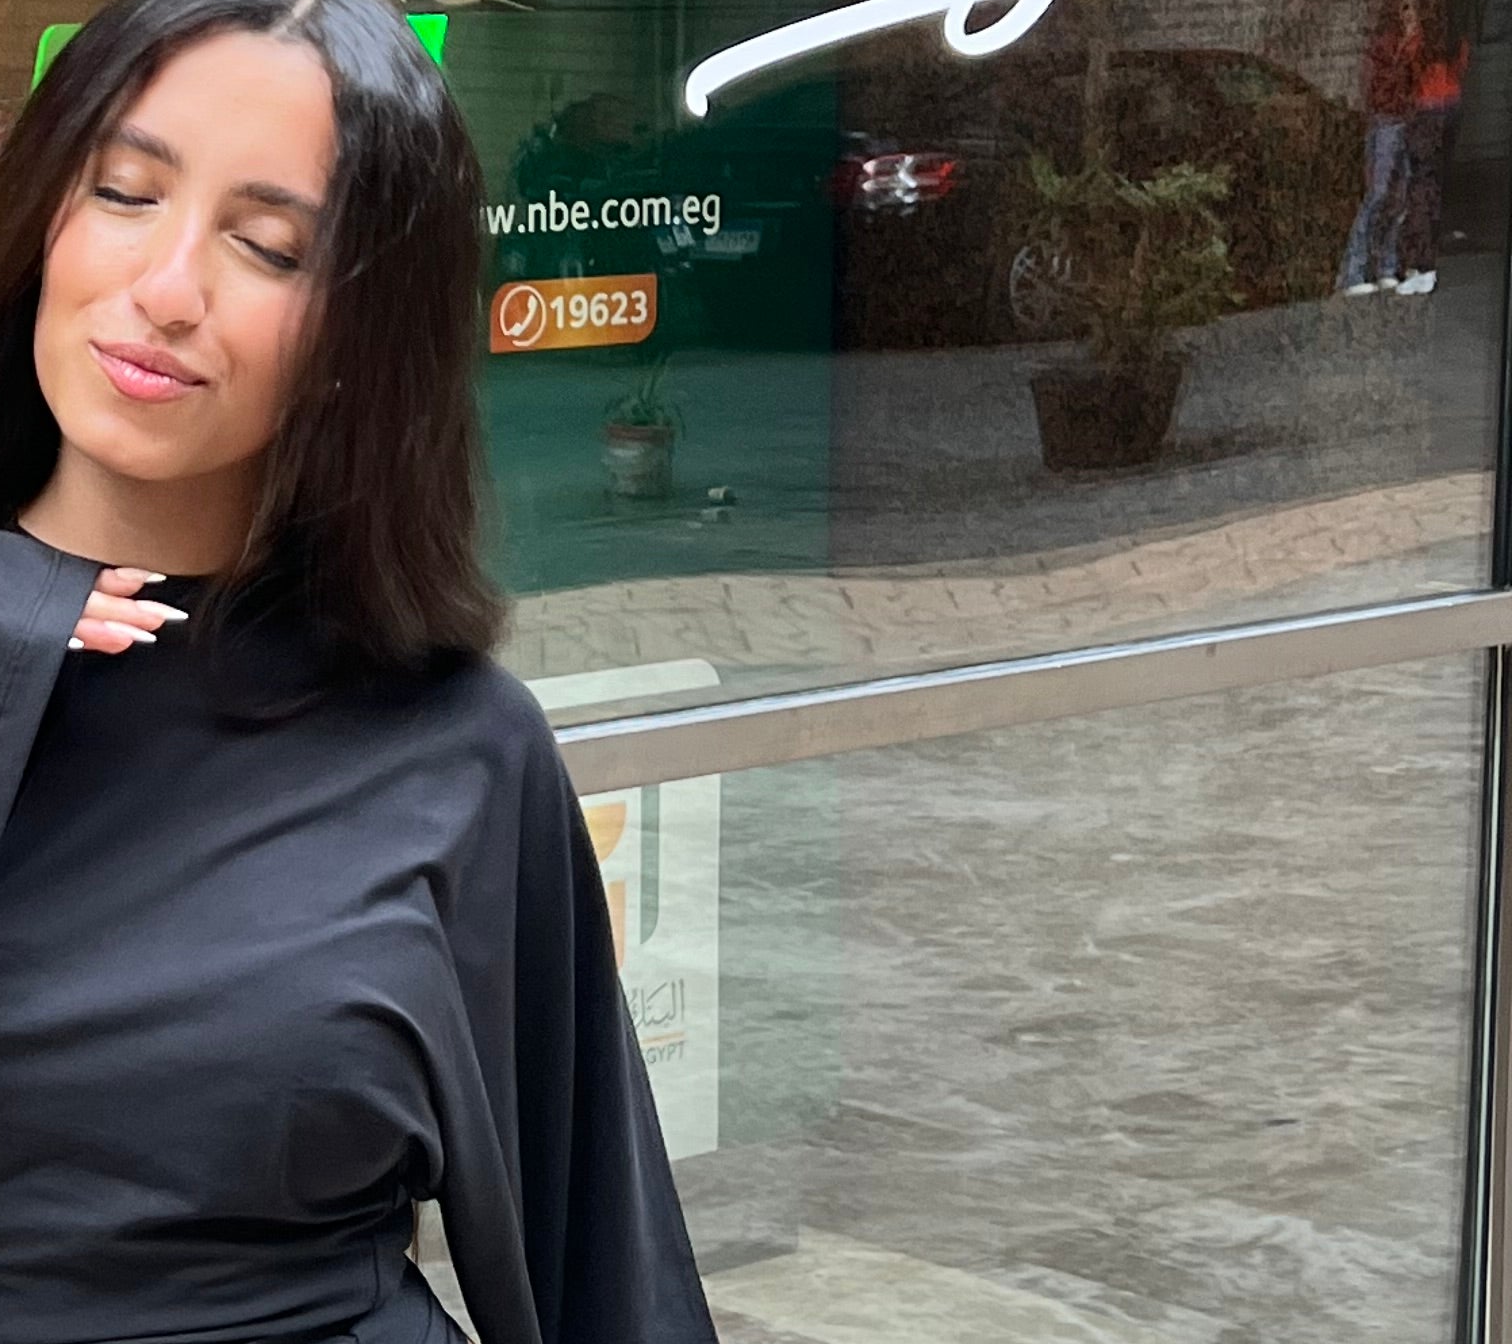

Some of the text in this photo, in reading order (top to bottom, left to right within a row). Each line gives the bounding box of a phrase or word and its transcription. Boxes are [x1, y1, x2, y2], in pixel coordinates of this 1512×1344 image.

[480, 190, 721, 235] w.nbe.com.eg
[549, 290, 648, 329] 19623
[641, 1040, 687, 1064] GYPT
